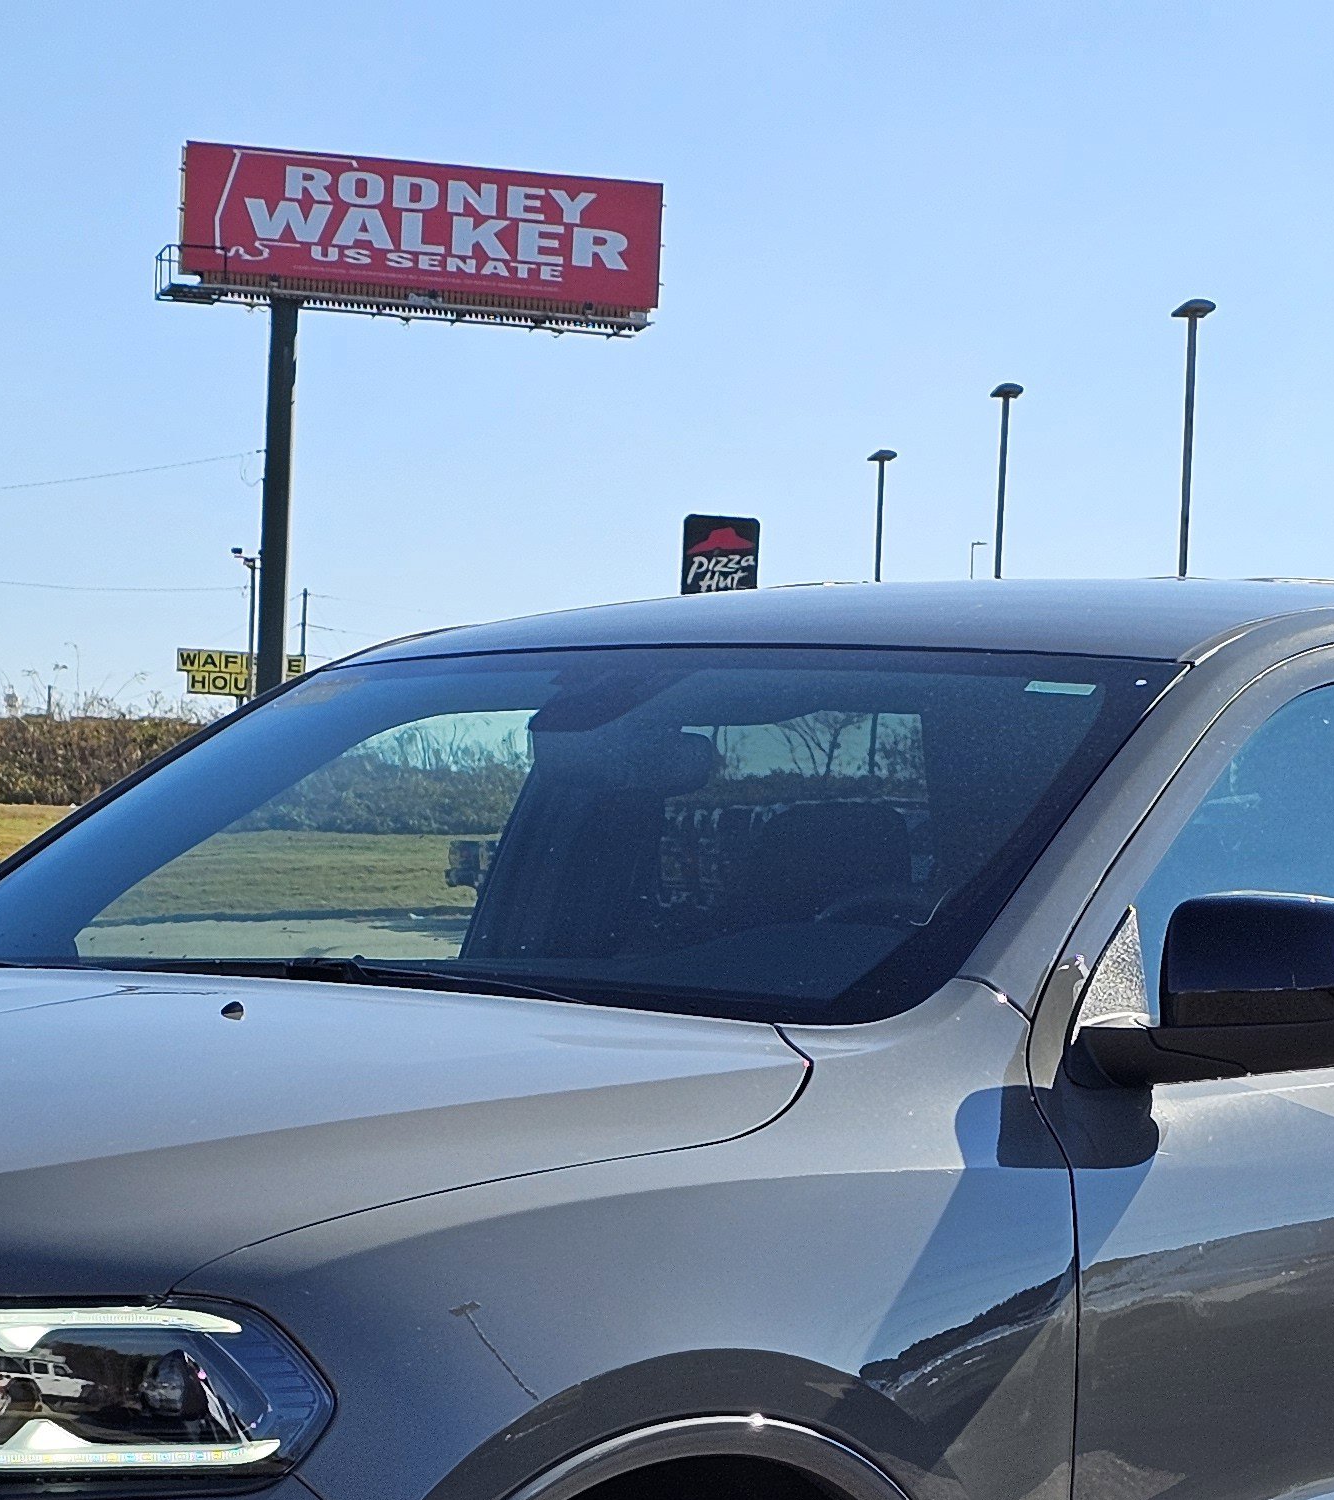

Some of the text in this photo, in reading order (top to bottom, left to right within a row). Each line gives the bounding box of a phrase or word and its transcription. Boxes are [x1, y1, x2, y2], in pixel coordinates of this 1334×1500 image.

[284, 164, 599, 224] RODNEY
[244, 197, 629, 271] WALKER
[310, 245, 372, 265] US
[385, 252, 563, 282] SENATE
[687, 553, 756, 585] Pizza
[699, 570, 748, 592] Hut
